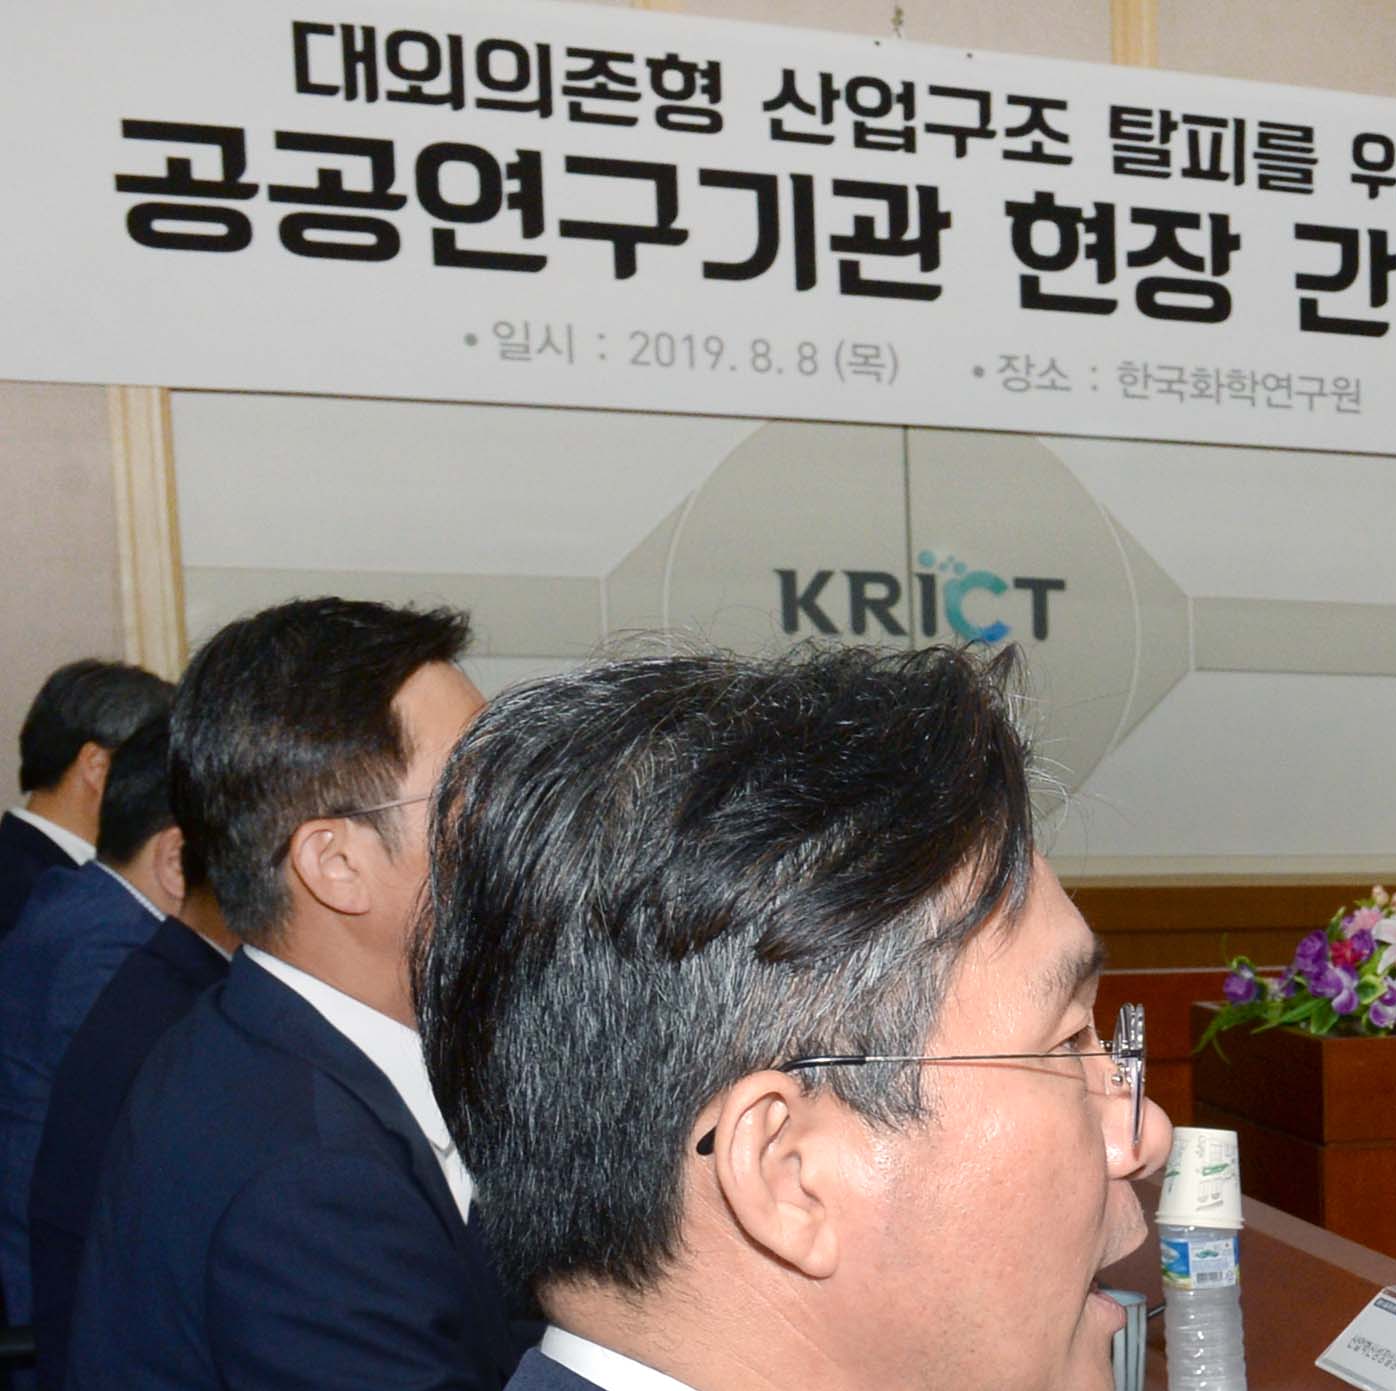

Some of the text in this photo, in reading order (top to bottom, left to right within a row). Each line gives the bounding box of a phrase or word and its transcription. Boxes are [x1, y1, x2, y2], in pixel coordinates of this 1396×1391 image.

[290, 19, 726, 135] 대외의존형
[762, 67, 1076, 167] 산업구조
[1108, 103, 1319, 195] 탈피를
[113, 118, 952, 302] 공공연구기관
[1005, 190, 1241, 324] 현장
[492, 320, 576, 364] 일시
[998, 354, 1072, 393] 장소
[1116, 359, 1362, 414] 한국화학연구원
[773, 562, 1067, 643] KRICT
